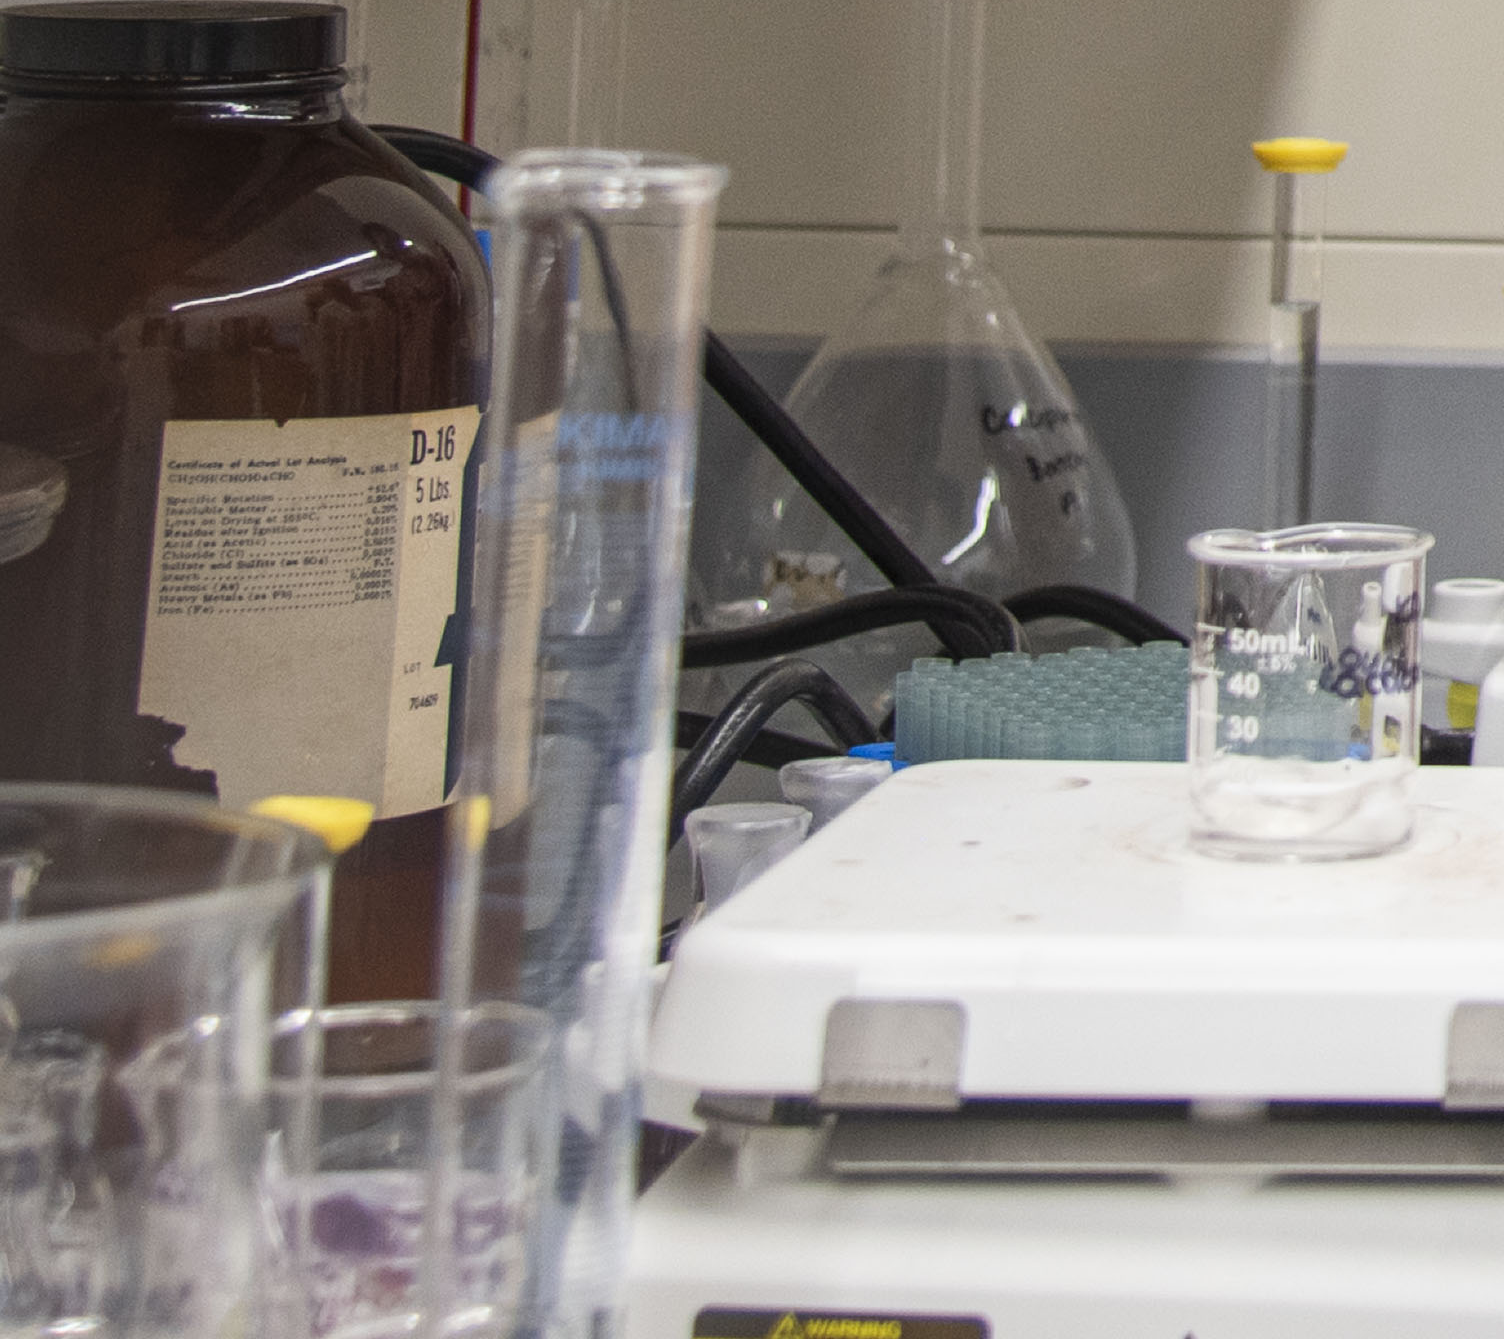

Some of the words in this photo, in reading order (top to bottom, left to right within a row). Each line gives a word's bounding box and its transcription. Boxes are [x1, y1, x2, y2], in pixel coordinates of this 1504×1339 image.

[409, 424, 456, 465] D-16
[415, 477, 424, 504] 5
[1226, 671, 1262, 700] 40
[1227, 715, 1260, 743] 30
